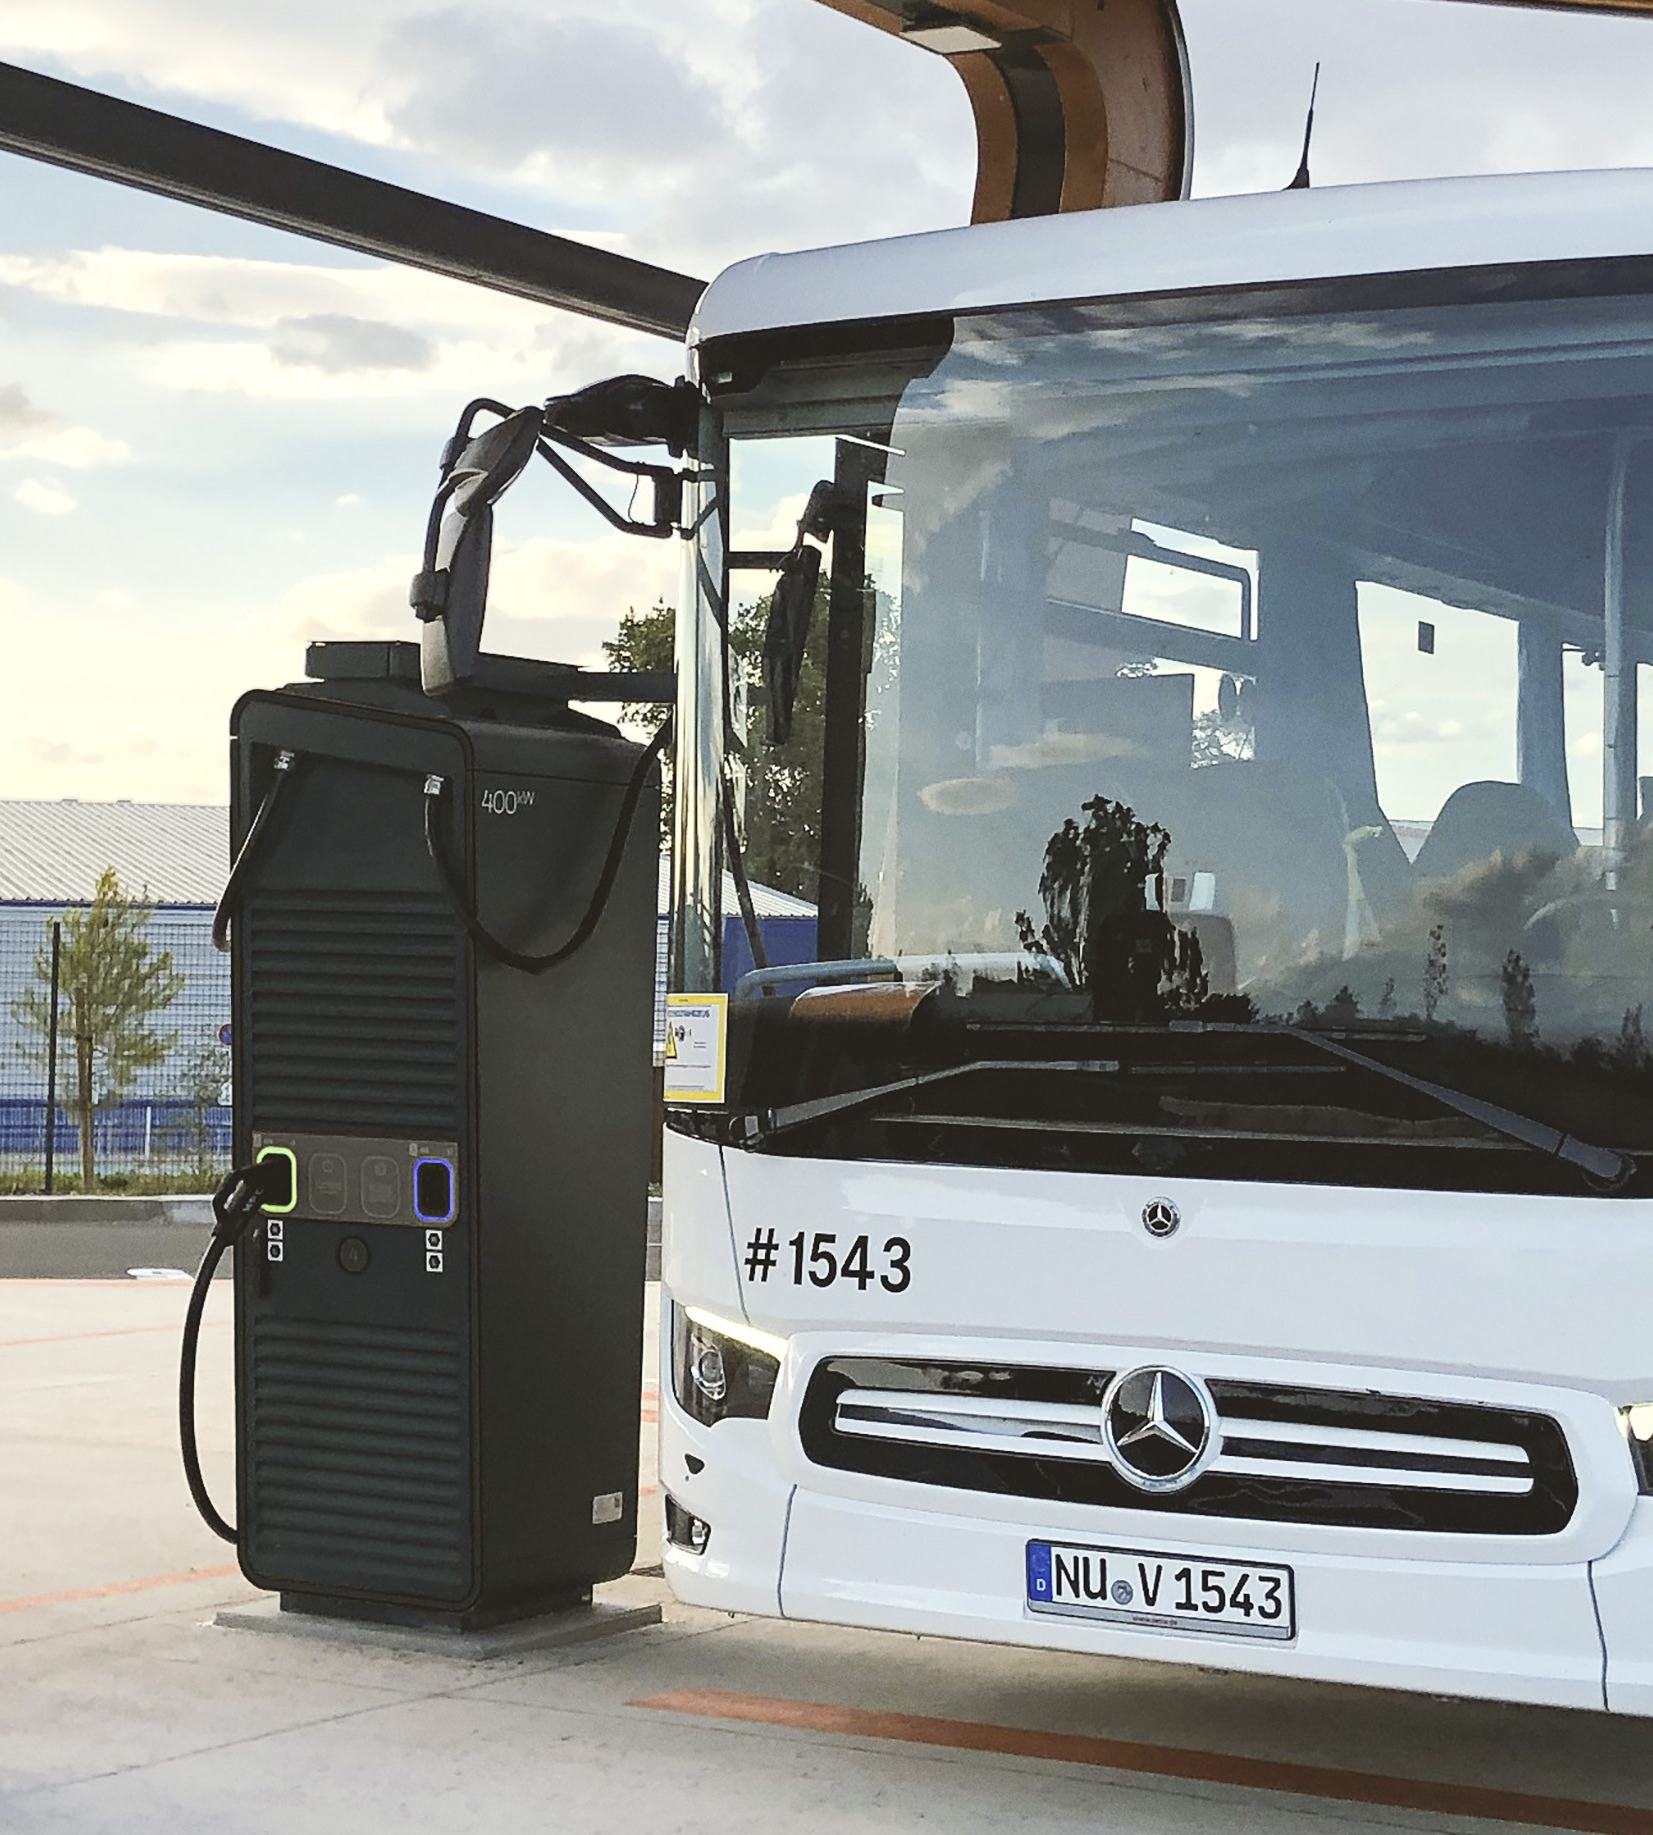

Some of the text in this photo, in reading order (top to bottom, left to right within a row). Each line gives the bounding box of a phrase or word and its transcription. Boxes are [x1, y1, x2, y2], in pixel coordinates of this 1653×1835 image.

[744, 1227, 911, 1293] #1543
[1036, 1553, 1282, 1620] D NU V 1543
